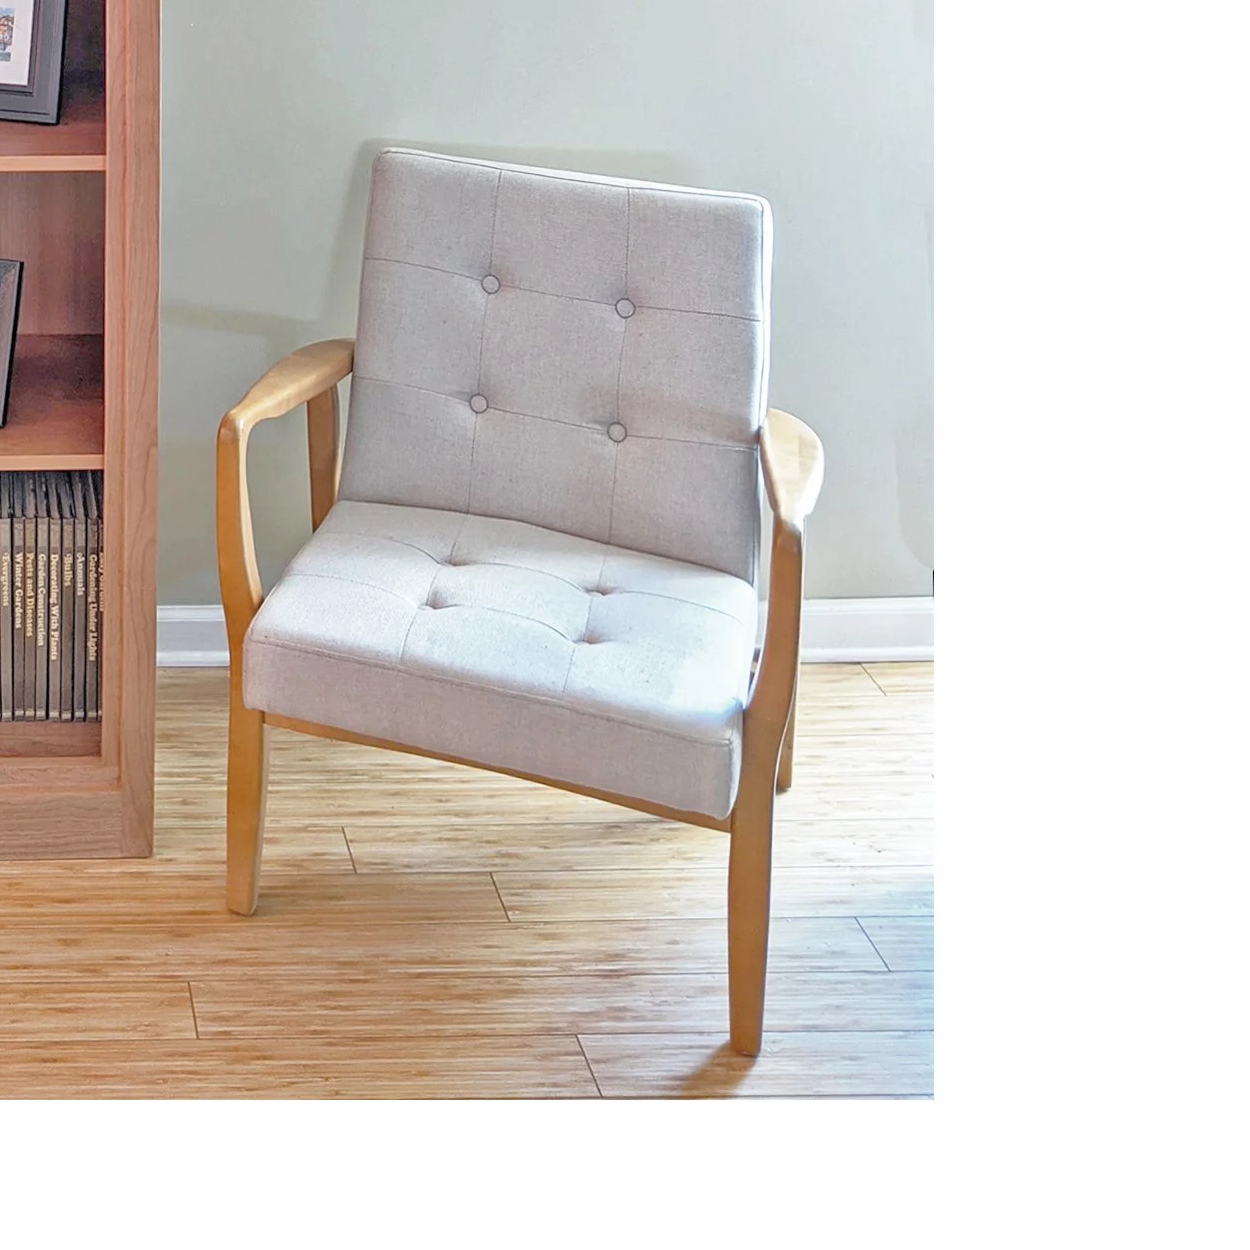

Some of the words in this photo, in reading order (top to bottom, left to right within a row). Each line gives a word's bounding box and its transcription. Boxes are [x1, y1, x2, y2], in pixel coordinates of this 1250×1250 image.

[1, 553, 11, 606] Evergreens
[15, 553, 23, 587] Winter
[26, 553, 34, 577] Pests
[38, 554, 46, 587] Garden
[49, 554, 59, 603] Decorating
[64, 554, 73, 586] Bulbs
[76, 552, 85, 595] Annuals
[88, 554, 98, 602] Gardening
[26, 578, 35, 596] and
[15, 589, 24, 628] Gardens
[26, 598, 35, 637] Diseases
[37, 587, 46, 646] Construction
[51, 605, 60, 629] With
[89, 603, 97, 631] Under
[50, 630, 60, 660] Plants
[87, 632, 98, 661] Lights
